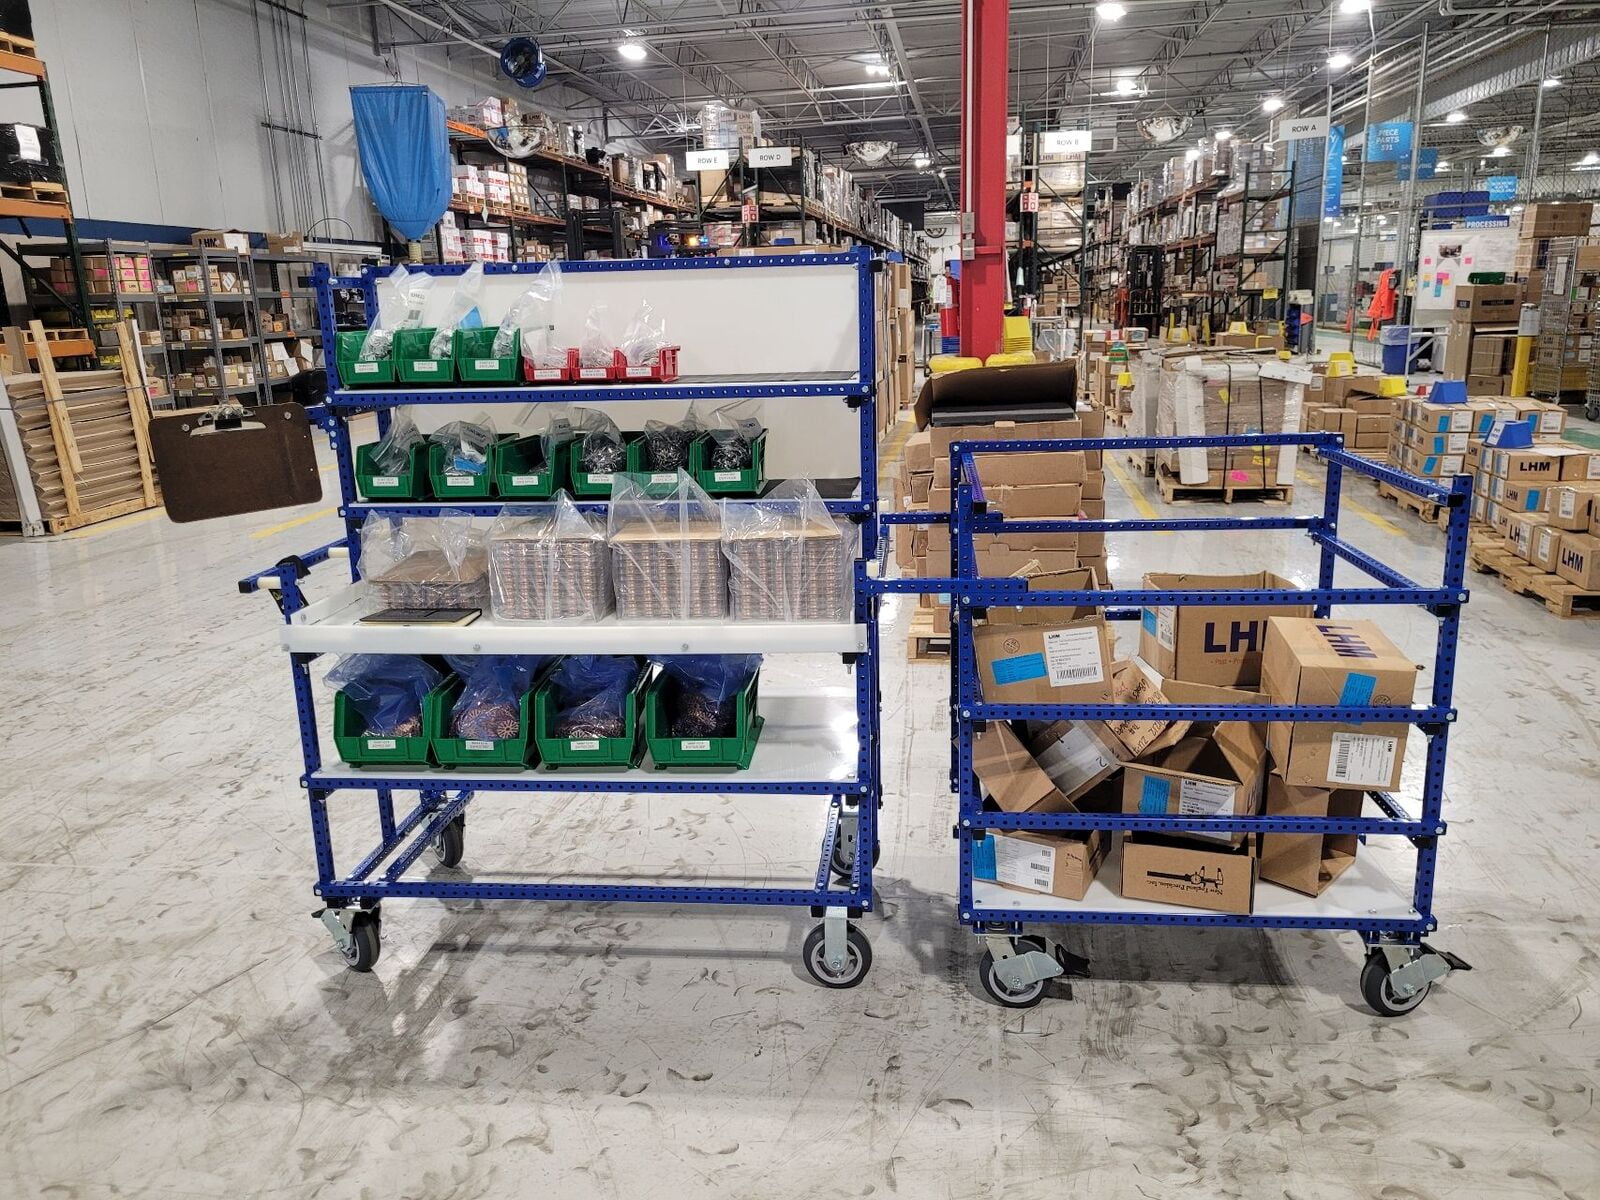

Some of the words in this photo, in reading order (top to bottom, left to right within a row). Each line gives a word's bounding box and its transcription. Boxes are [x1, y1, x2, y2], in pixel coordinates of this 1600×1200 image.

[1466, 219, 1508, 228] PROCESSING
[1519, 461, 1551, 472] LHM
[1506, 488, 1519, 501] LHM
[1561, 547, 1584, 573] LHM
[1204, 620, 1268, 654] LH
[1316, 623, 1378, 660] LHM
[1186, 884, 1209, 893] England
[1210, 888, 1223, 896] New
